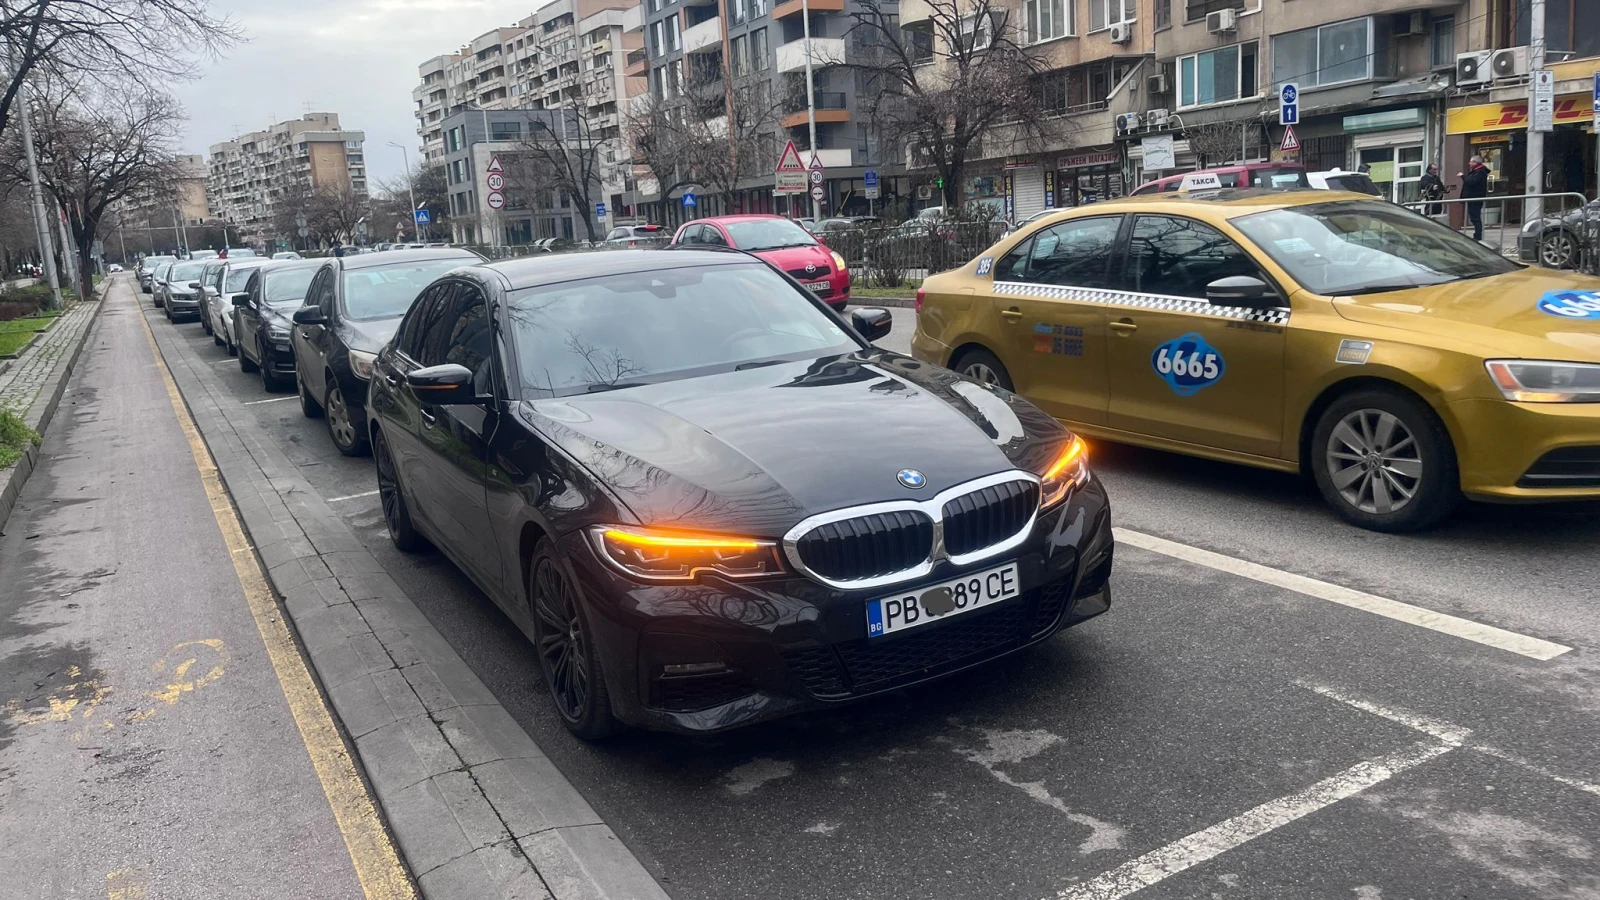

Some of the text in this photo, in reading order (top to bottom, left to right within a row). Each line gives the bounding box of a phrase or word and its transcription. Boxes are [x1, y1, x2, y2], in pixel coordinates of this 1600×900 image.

[1499, 100, 1580, 125] DL
[490, 177, 502, 187] 30
[812, 173, 821, 182] 30
[1157, 349, 1218, 379] 6665
[885, 595, 919, 629] PB
[986, 567, 1015, 600] CE
[870, 622, 882, 633] BG
